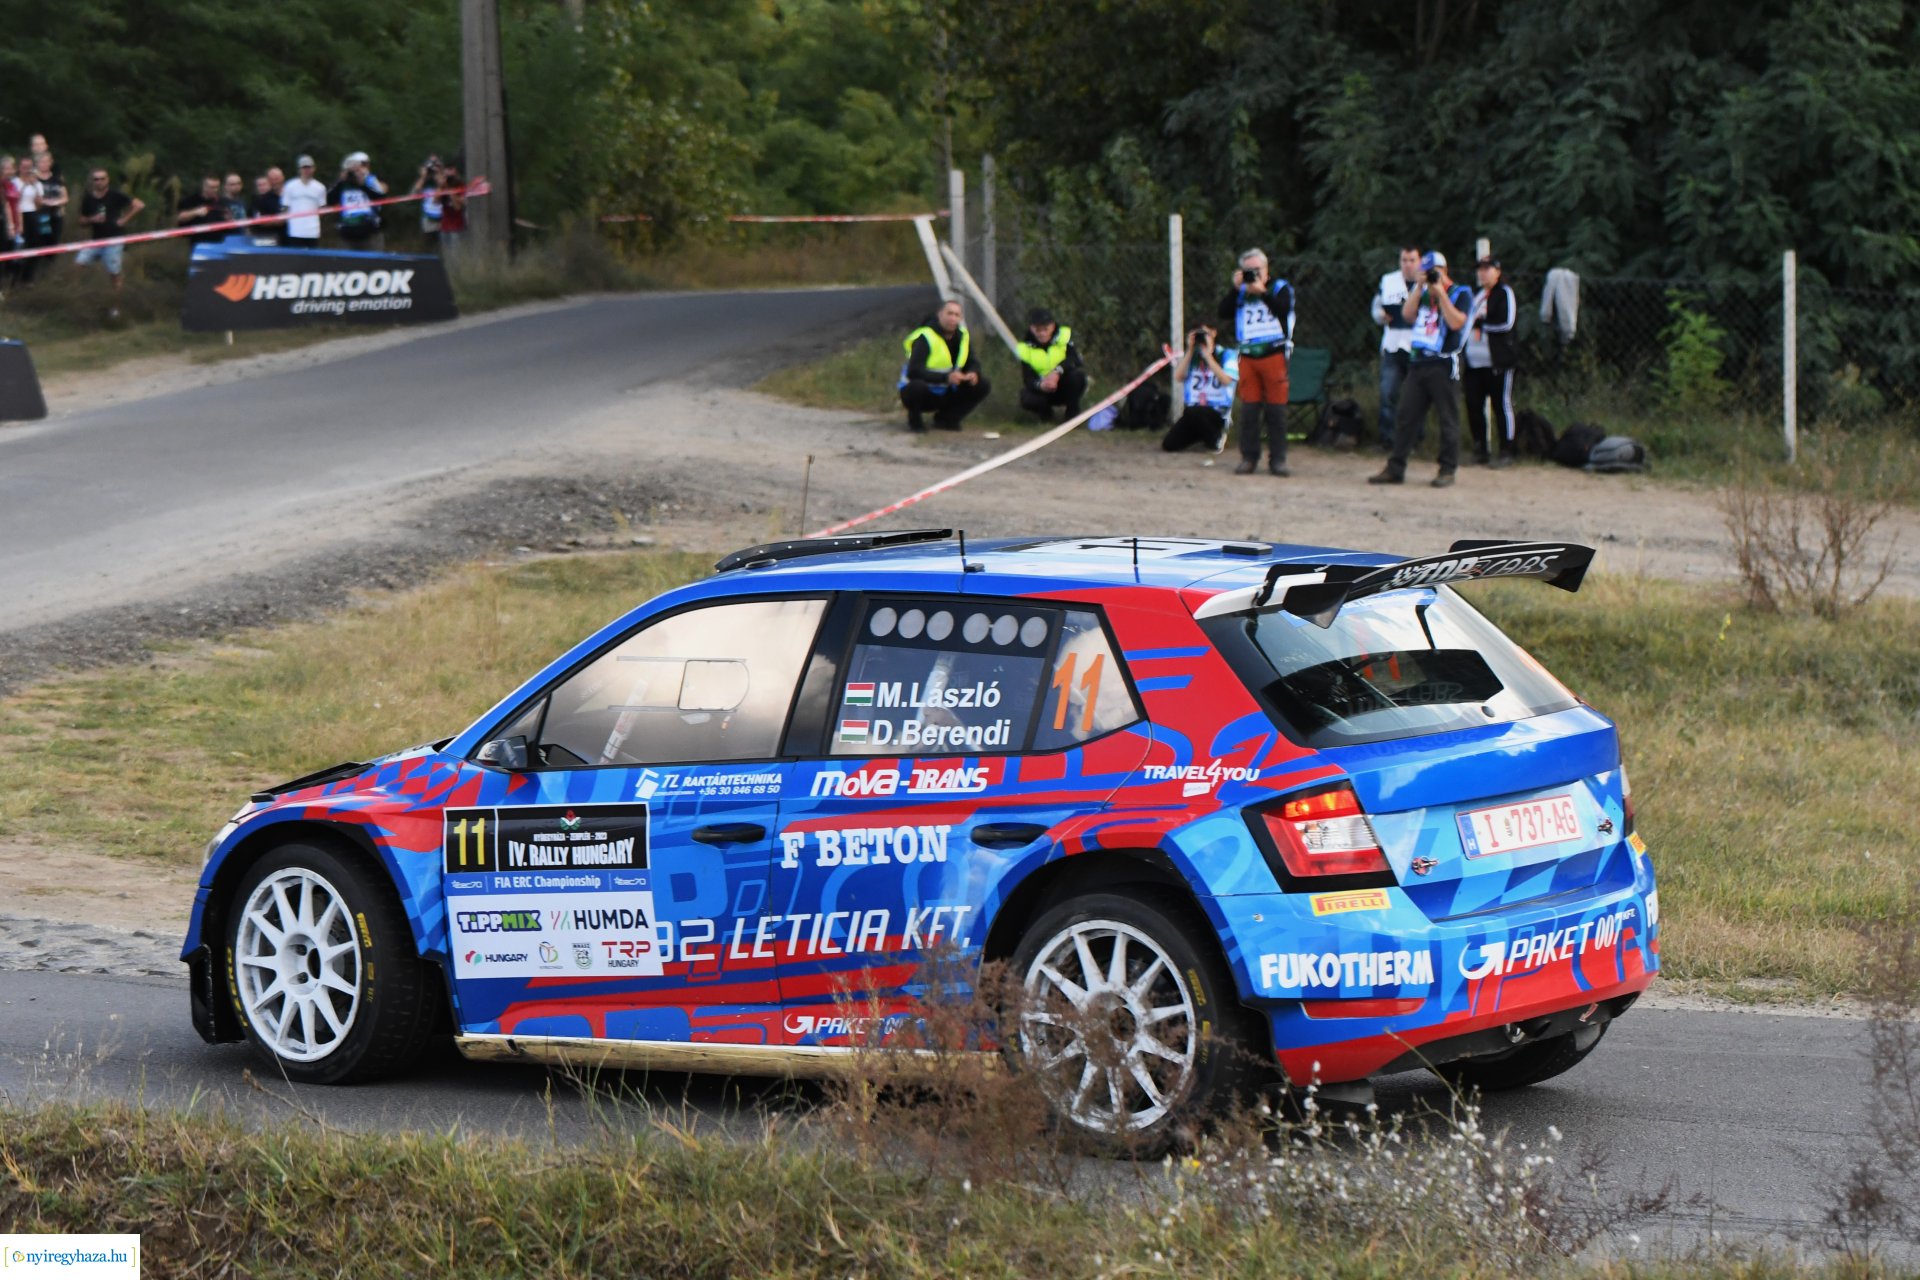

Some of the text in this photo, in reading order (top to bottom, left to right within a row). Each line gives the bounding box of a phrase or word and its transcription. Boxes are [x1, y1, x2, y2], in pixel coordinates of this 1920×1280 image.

[292, 297, 412, 315] driving emotion
[877, 680, 1001, 708] M.László
[1052, 652, 1105, 732] 11
[872, 719, 1010, 746] D.Berendi
[683, 772, 782, 787] RAKTÁRTECHNIKA
[1143, 758, 1260, 788] TRAVEL4YOU
[699, 787, 716, 796] +36
[718, 786, 731, 795] 30
[732, 786, 751, 795] 846
[753, 785, 764, 794] 68
[767, 785, 781, 793] 50
[453, 818, 485, 866] 11
[508, 837, 635, 867] IV. RALLY HUNGARY
[779, 825, 952, 869] F BETON
[494, 875, 601, 890] FIA ERC Championship
[1315, 892, 1385, 912] PIRELLI
[574, 909, 649, 931] HUMDA
[729, 908, 890, 961] LETICIA
[901, 905, 972, 950] KFT.
[602, 941, 651, 958] TRP
[1505, 921, 1594, 973] PAKET
[1594, 912, 1624, 951] 007
[485, 953, 528, 963] HUNGARY
[1260, 950, 1435, 989] FUKOTHERM
